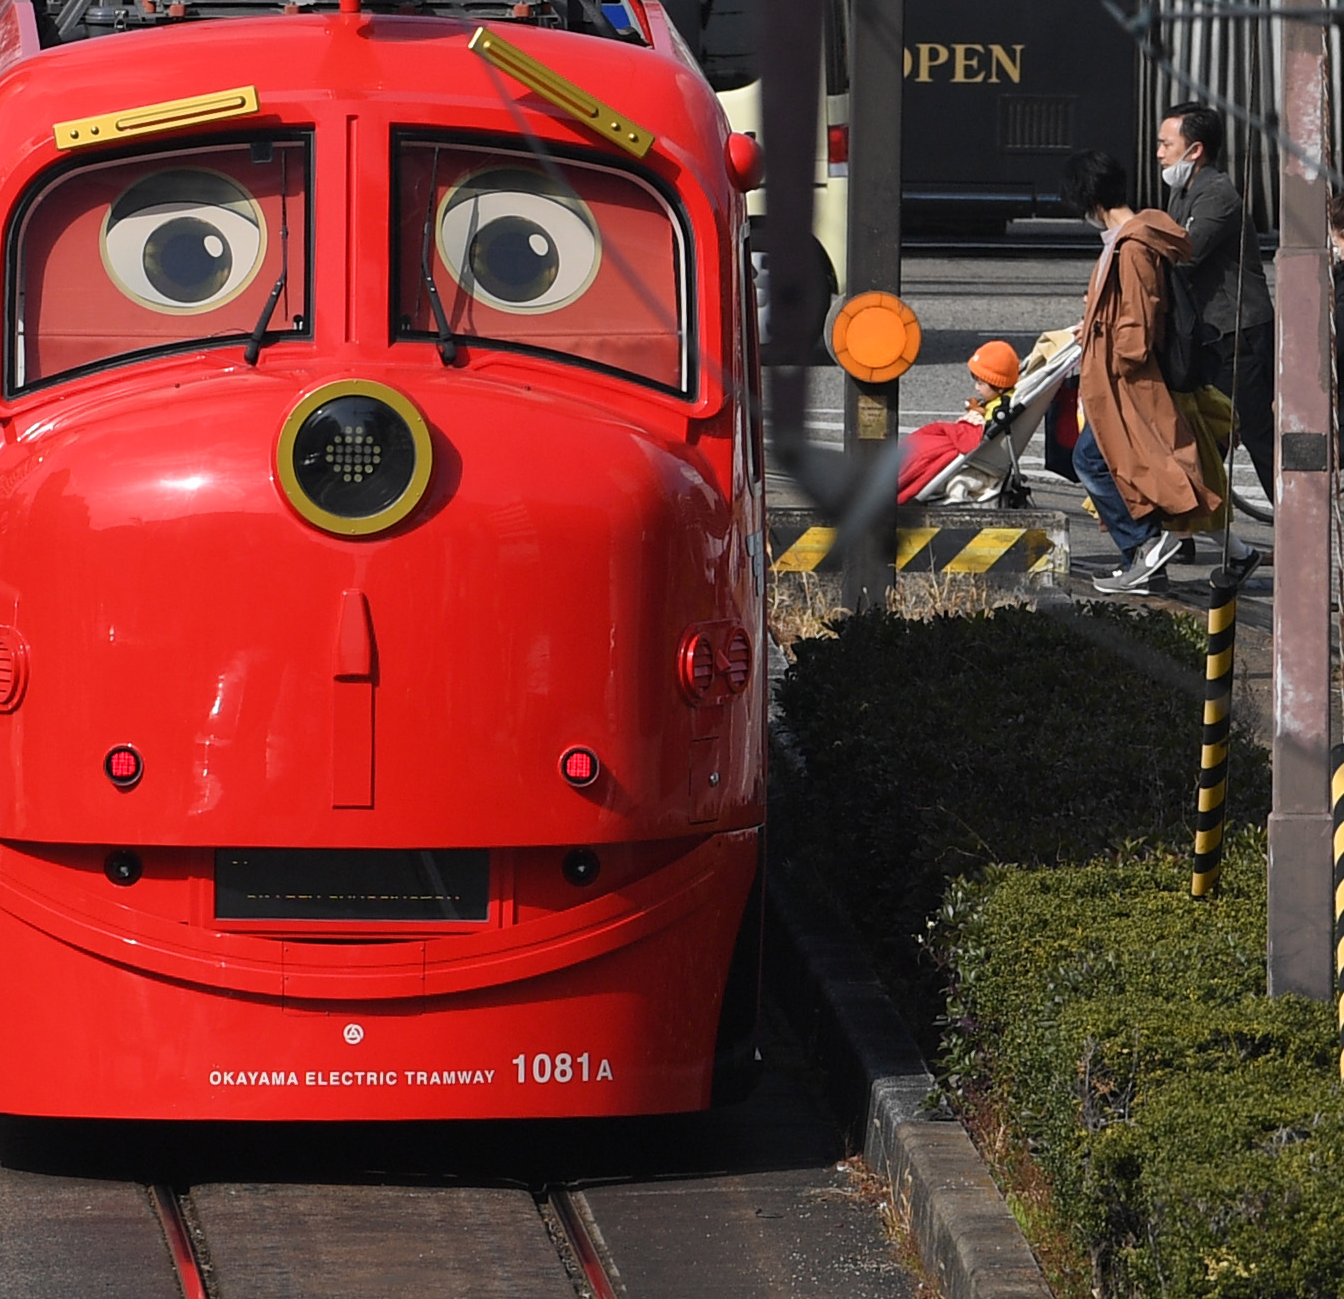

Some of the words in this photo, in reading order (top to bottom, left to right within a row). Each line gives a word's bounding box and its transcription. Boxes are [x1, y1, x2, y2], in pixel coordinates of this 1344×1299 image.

[903, 43, 1025, 84] PEN
[208, 1070, 299, 1086] OKAYAMA
[305, 1070, 398, 1086] ELECTRIC
[403, 1069, 495, 1086] TRAMWAY
